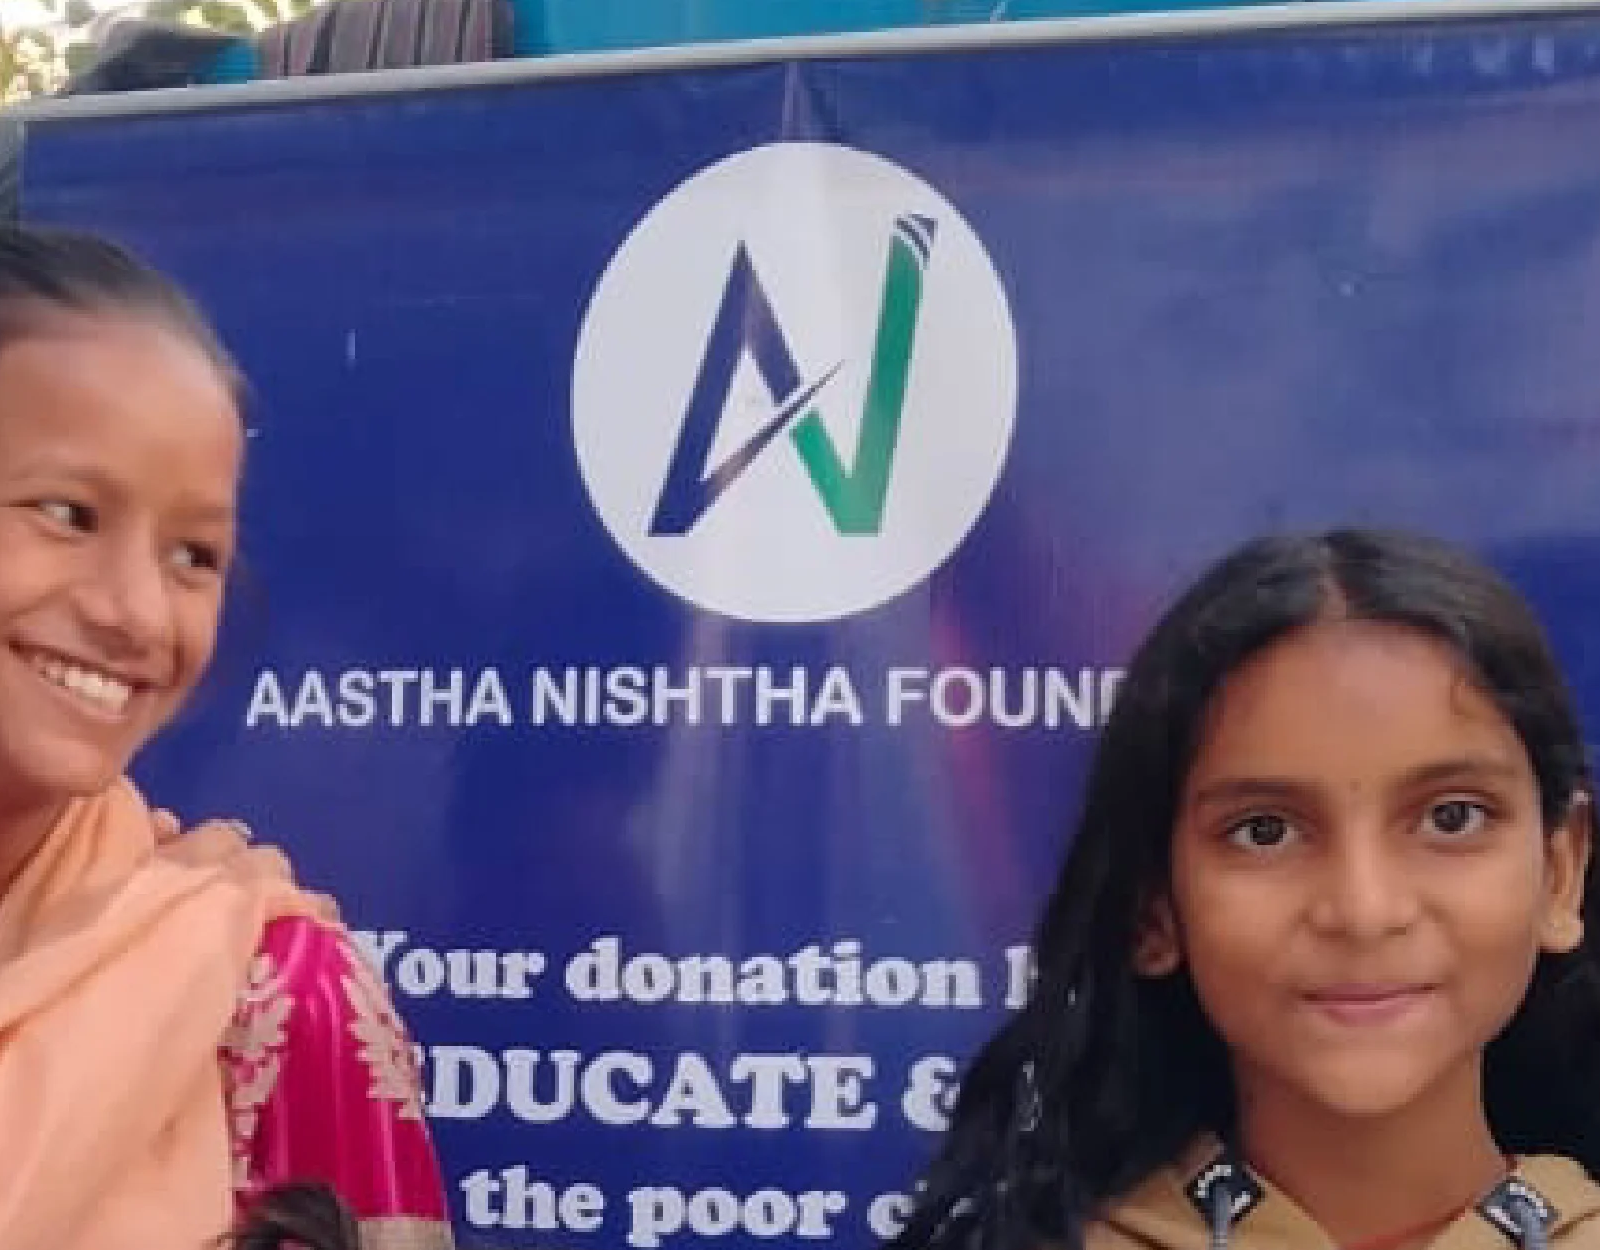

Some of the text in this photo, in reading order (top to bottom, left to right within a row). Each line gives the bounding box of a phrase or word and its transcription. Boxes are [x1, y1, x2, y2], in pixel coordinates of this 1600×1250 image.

[246, 668, 513, 728] AASTHA
[532, 666, 864, 728] NISHTHA
[565, 935, 983, 1007] donation
[417, 1044, 877, 1129] DUCATE
[460, 1164, 604, 1232] the
[626, 1185, 848, 1248] poor
